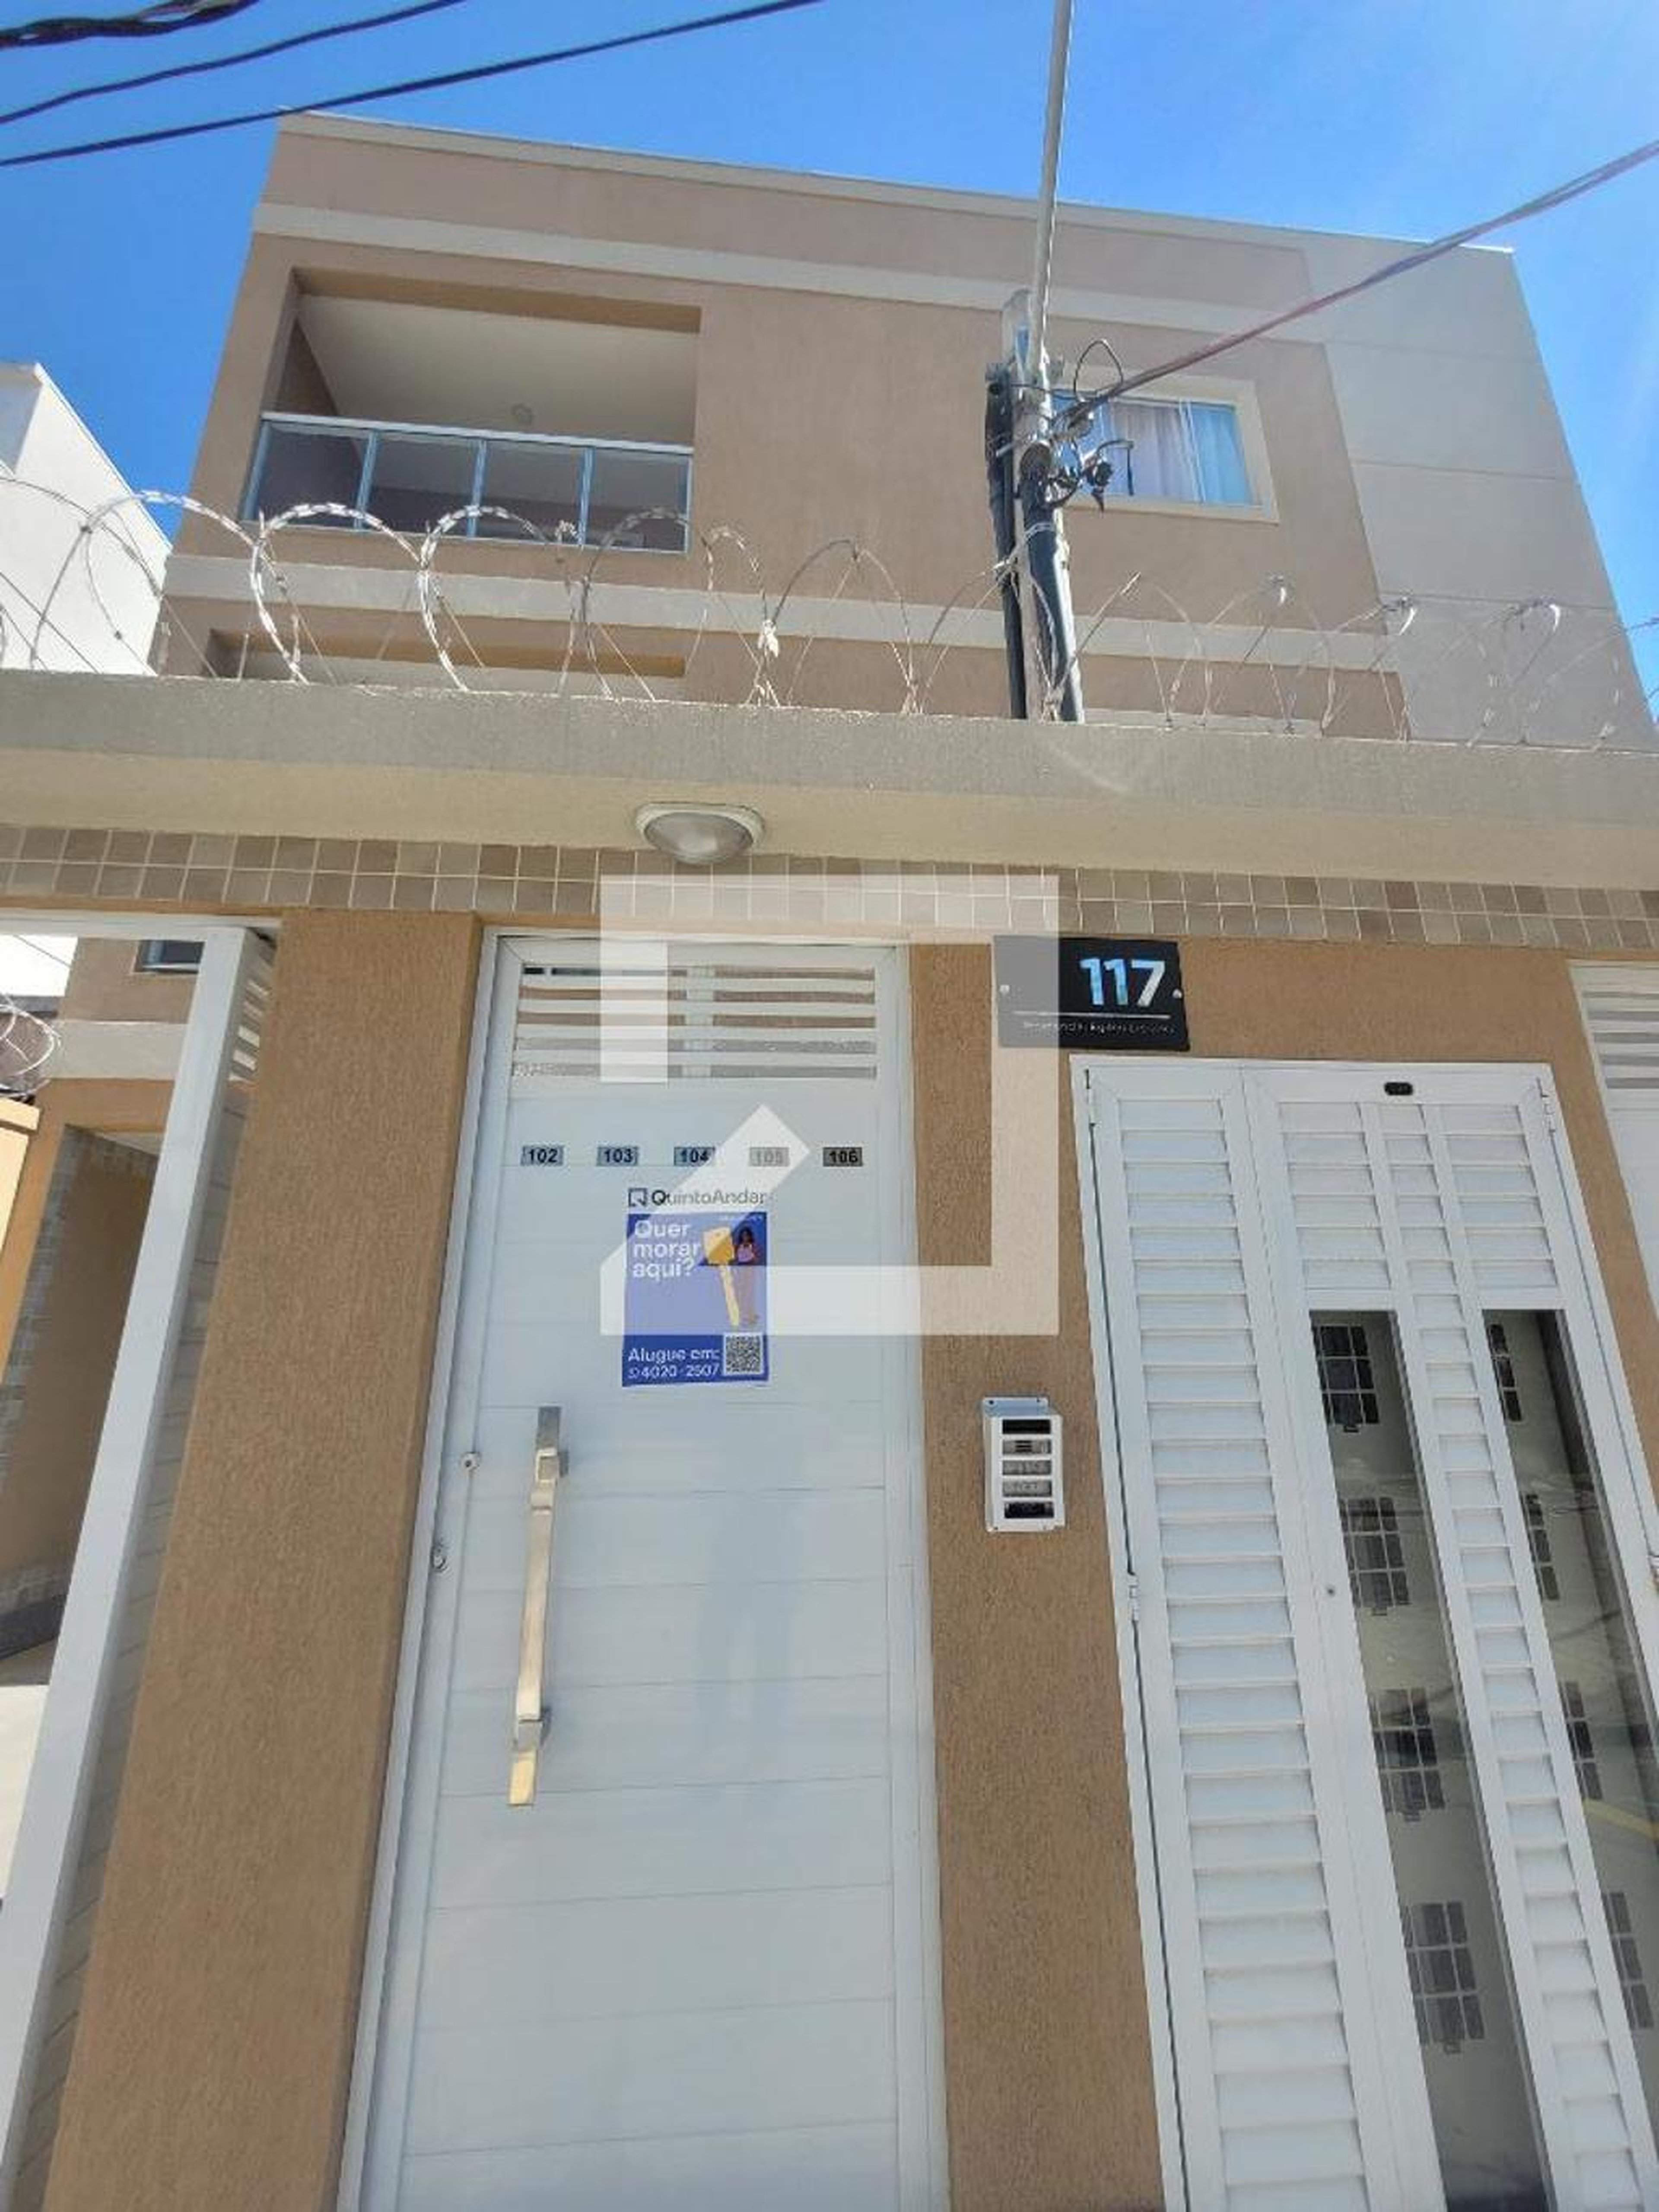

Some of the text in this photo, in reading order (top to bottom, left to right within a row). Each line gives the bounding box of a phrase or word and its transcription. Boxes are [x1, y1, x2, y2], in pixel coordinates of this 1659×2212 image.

[1079, 958, 1166, 1008] 117
[528, 1148, 558, 1163] 102
[604, 1148, 634, 1163] 103
[680, 1149, 710, 1163] 104
[829, 1149, 858, 1164] 106
[651, 1190, 766, 1206] QuintoAndar
[634, 1219, 690, 1239] Quer
[633, 1243, 702, 1258] morar
[632, 1258, 695, 1282] aqui?
[628, 1347, 686, 1363] Alugue
